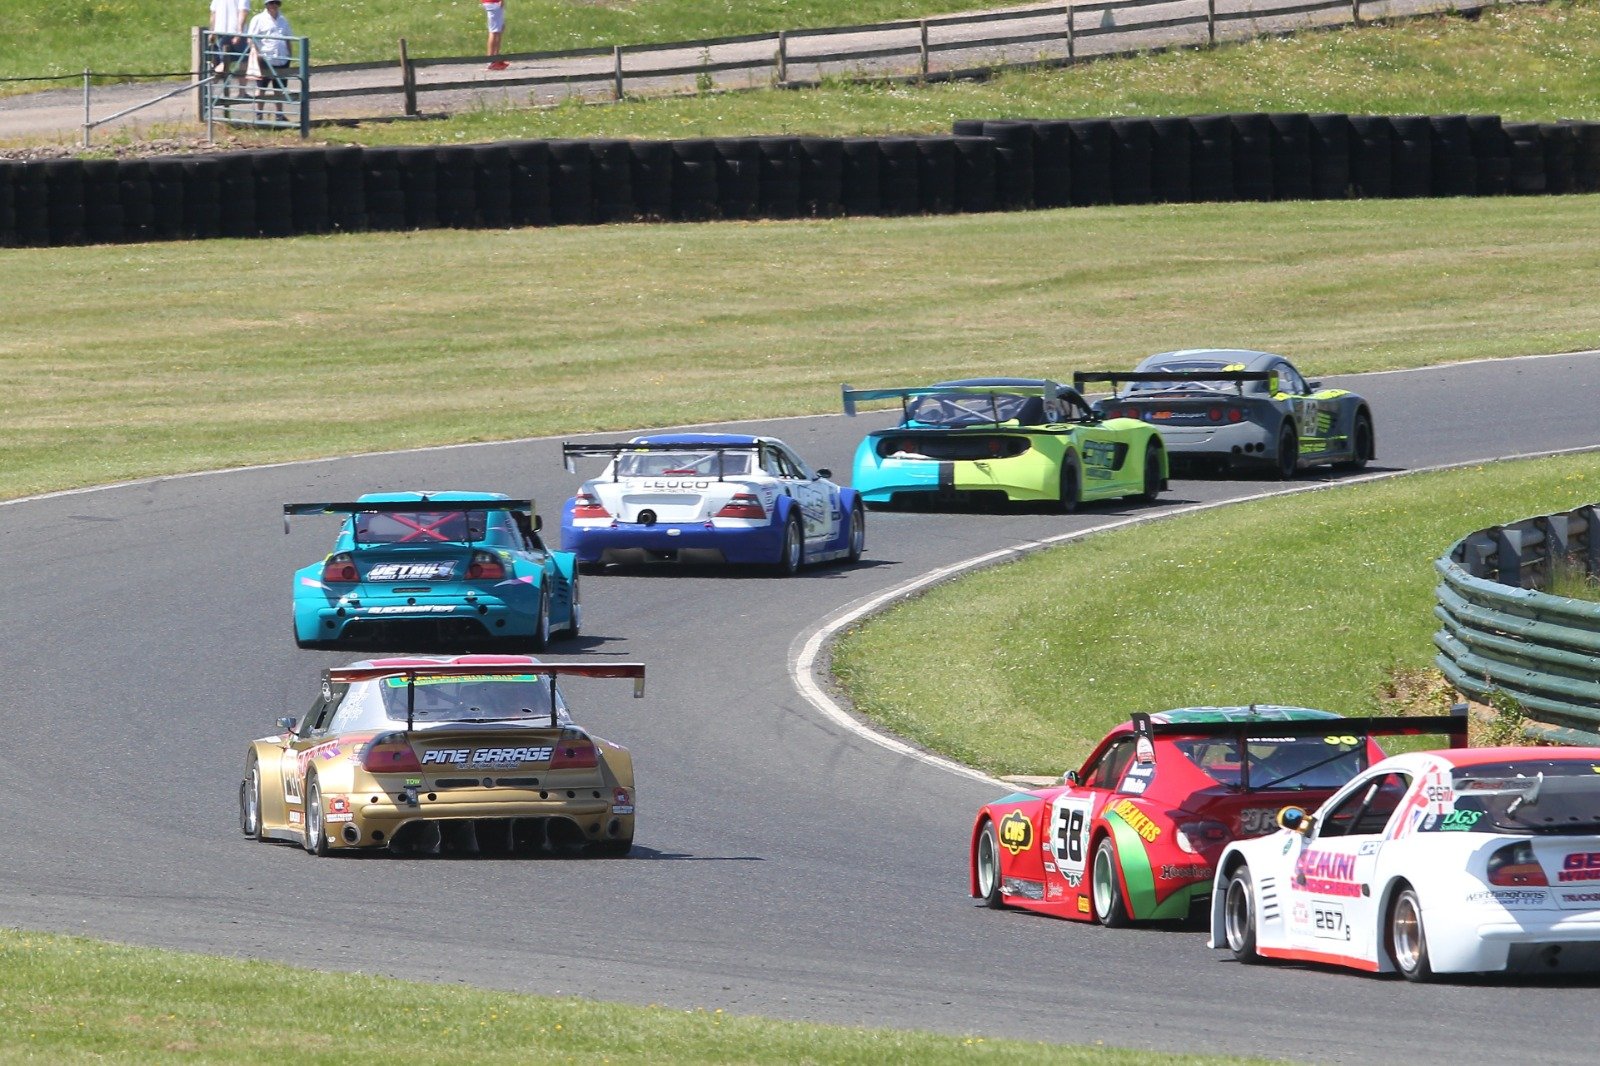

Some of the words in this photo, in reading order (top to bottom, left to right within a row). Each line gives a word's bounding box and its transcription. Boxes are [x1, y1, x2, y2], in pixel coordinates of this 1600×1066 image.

[421, 749, 470, 764] PINE
[472, 747, 553, 762] GARAGE
[1443, 809, 1483, 825] DGS
[1057, 807, 1084, 862] 38
[1296, 848, 1357, 881] GEMINI
[1315, 908, 1343, 931] 267
